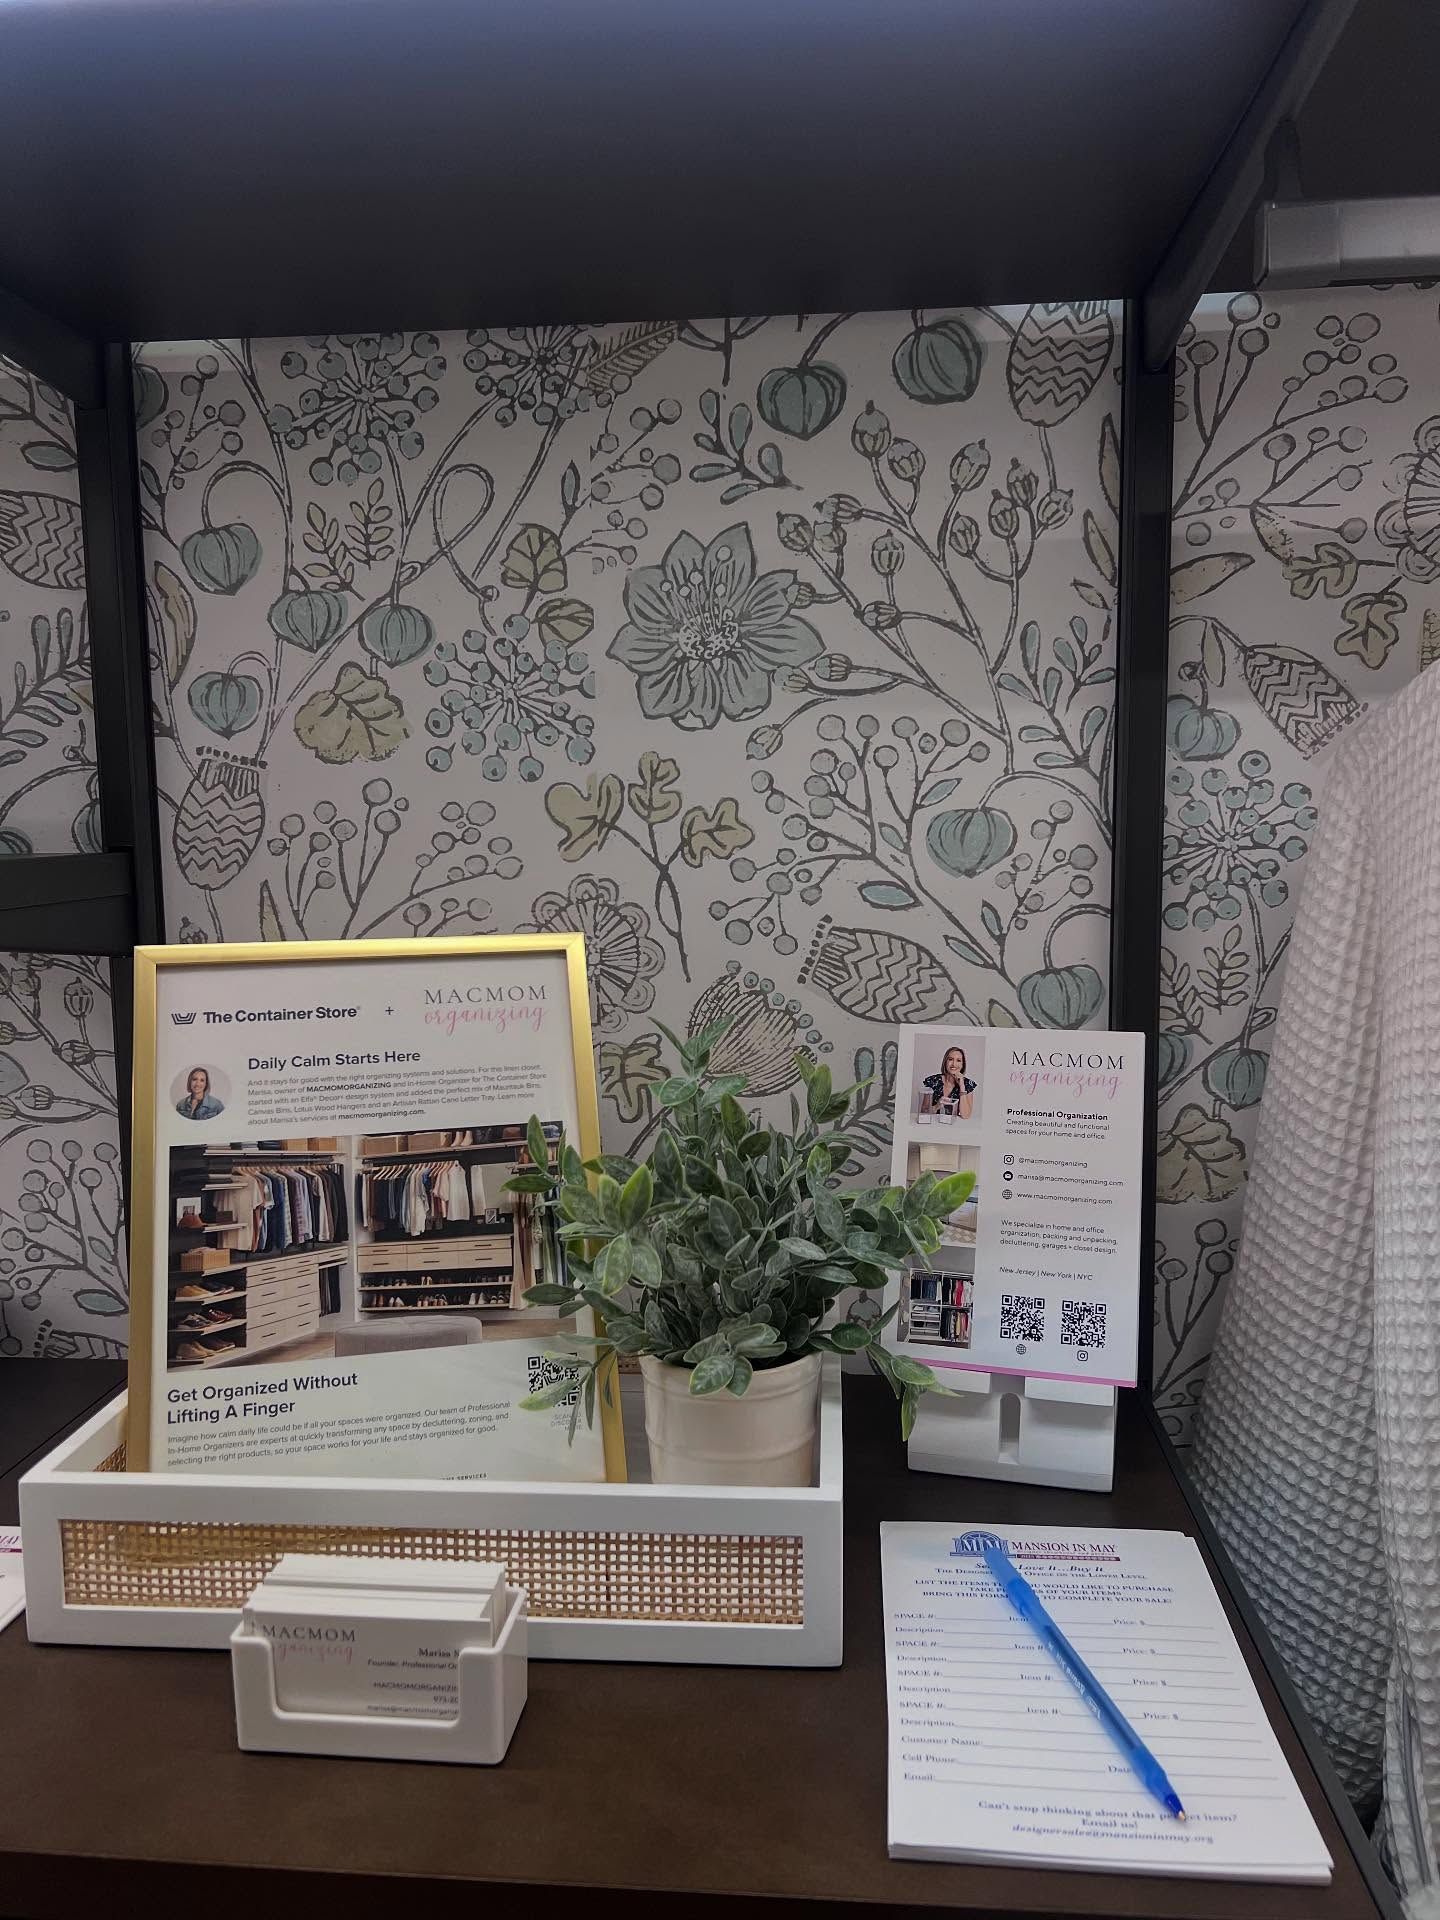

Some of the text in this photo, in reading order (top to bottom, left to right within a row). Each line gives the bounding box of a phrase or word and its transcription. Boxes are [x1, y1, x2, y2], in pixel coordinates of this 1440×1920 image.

[424, 985, 548, 1005] MACMOM
[204, 1011, 234, 1024] The
[235, 1008, 314, 1023] Container
[424, 1006, 546, 1036] organizing
[248, 1051, 421, 1072] Daily Calm Starts Here
[1011, 1051, 1124, 1070] MACMOM
[306, 1081, 392, 1093] MACMOMORGANIZING
[1009, 1071, 1122, 1098] organizing
[1007, 1108, 1108, 1122] Professional Organization
[1006, 1118, 1110, 1131] Creating beautiful and functional
[1005, 1128, 1085, 1139] spaces for your home and
[1018, 1157, 1088, 1168] @macmomorganizing
[1017, 1174, 1124, 1187] marisa@macmomorganizing.com
[1016, 1192, 1113, 1205] www.macmomorganizing.com
[1000, 1219, 1013, 1227] We
[1013, 1221, 1044, 1229] specialize
[1045, 1222, 1052, 1230] in
[1052, 1223, 1072, 1231] home
[1085, 1225, 1105, 1234] office
[1042, 1232, 1068, 1242] packing
[1068, 1234, 1082, 1242] and
[1042, 1243, 1068, 1251] garages
[1073, 1244, 1093, 1252] closet
[1000, 1266, 1093, 1282] New Jersey New York NYC
[167, 1373, 358, 1402] Get Organized Without
[167, 1402, 296, 1424] Lifting A Finger
[200, 1432, 216, 1441] how
[218, 1429, 237, 1439] calm
[238, 1427, 256, 1437] daily
[257, 1426, 268, 1435] life
[270, 1423, 290, 1434] could
[292, 1422, 302, 1431] be
[304, 1421, 309, 1430] if
[310, 1420, 319, 1429] all
[319, 1421, 336, 1430] your
[338, 1418, 364, 1428] spaces
[365, 1416, 384, 1424] were
[424, 1409, 438, 1417] Our
[440, 1408, 458, 1416] team
[458, 1405, 466, 1414] of
[467, 1401, 510, 1413] Professional
[203, 1440, 244, 1452] Organizers
[246, 1439, 258, 1447] are
[260, 1435, 288, 1446] experts
[290, 1433, 298, 1442] at
[298, 1431, 324, 1443] quickly
[326, 1427, 372, 1438] transforming
[388, 1424, 410, 1433] space
[411, 1422, 421, 1431] by
[495, 1412, 510, 1421] and
[168, 1456, 203, 1467] selecting
[204, 1454, 216, 1463] the
[218, 1451, 236, 1462] right
[285, 1447, 302, 1456] your
[303, 1444, 326, 1454] space
[327, 1440, 350, 1450] works
[350, 1439, 361, 1447] for
[362, 1439, 380, 1448] your
[380, 1435, 392, 1444] life
[394, 1434, 408, 1443] and
[408, 1433, 428, 1442] stays
[428, 1428, 464, 1440] organized
[466, 1427, 476, 1435] for
[1012, 1541, 1116, 1554] MANSION IN MAY
[1042, 1582, 1078, 1590] WOULD
[1080, 1583, 1106, 1591] LIKE
[1122, 1584, 1174, 1593] PURCHASE
[1061, 1588, 1088, 1596] YOUR
[1090, 1589, 1122, 1597] ITEMS
[922, 1590, 954, 1598] BRING
[1058, 1594, 1113, 1602] COMPLETE
[262, 1625, 356, 1642] MACMOM
[1012, 1803, 1039, 1813] stop
[1042, 1803, 1092, 1816] thinking
[1094, 1806, 1128, 1816] about
[1132, 1807, 1156, 1817] that
[1082, 1817, 1118, 1828] Email
